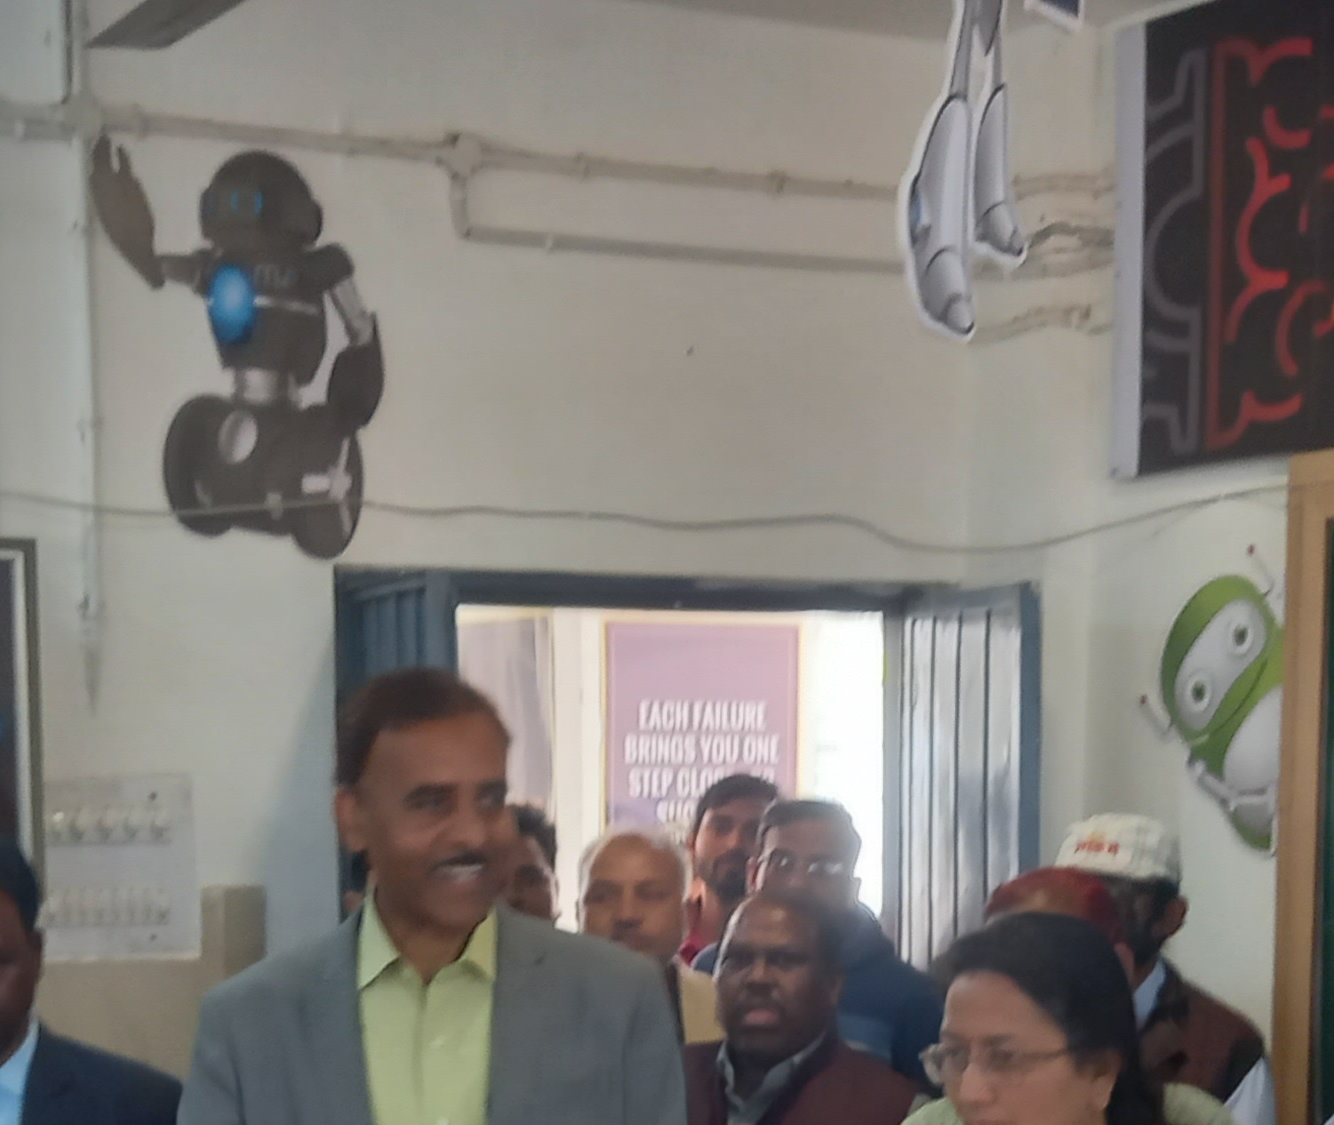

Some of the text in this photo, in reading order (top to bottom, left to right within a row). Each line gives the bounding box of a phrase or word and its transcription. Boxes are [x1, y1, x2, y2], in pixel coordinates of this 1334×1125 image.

[638, 700, 767, 731] EACH FAILURE
[624, 733, 779, 765] BRINGS YOU ONE
[629, 766, 673, 798] STEP
